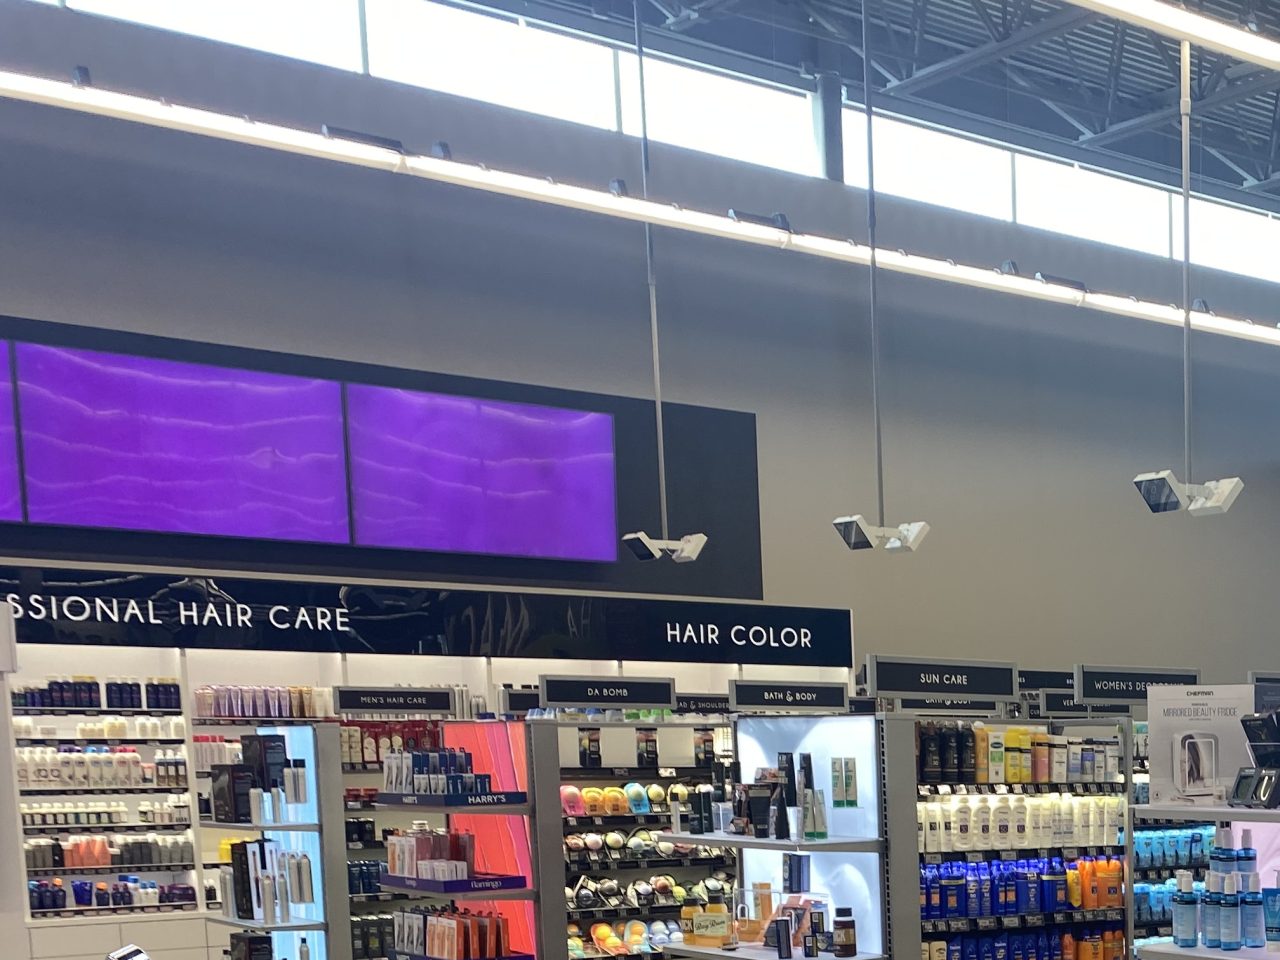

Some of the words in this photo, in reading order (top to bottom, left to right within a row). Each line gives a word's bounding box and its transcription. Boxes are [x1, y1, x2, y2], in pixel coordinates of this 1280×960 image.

[6, 593, 163, 624] SSIONAL
[179, 601, 252, 628] HAIR
[269, 604, 350, 632] CARE
[666, 622, 720, 645] HAIR
[731, 625, 812, 648] COLOR
[920, 673, 940, 684] SUN
[943, 673, 968, 685] CARE
[1094, 680, 1133, 691] WOMEN'S
[587, 687, 601, 697] DA
[603, 687, 629, 697] BOMB
[763, 691, 784, 701] BATH
[785, 689, 793, 702] &
[795, 691, 817, 701] BODY
[360, 696, 384, 704] MEN'S
[1193, 707, 1217, 717] BEAUTY
[468, 794, 507, 804] HARRY'S
[471, 880, 502, 889] flamingo
